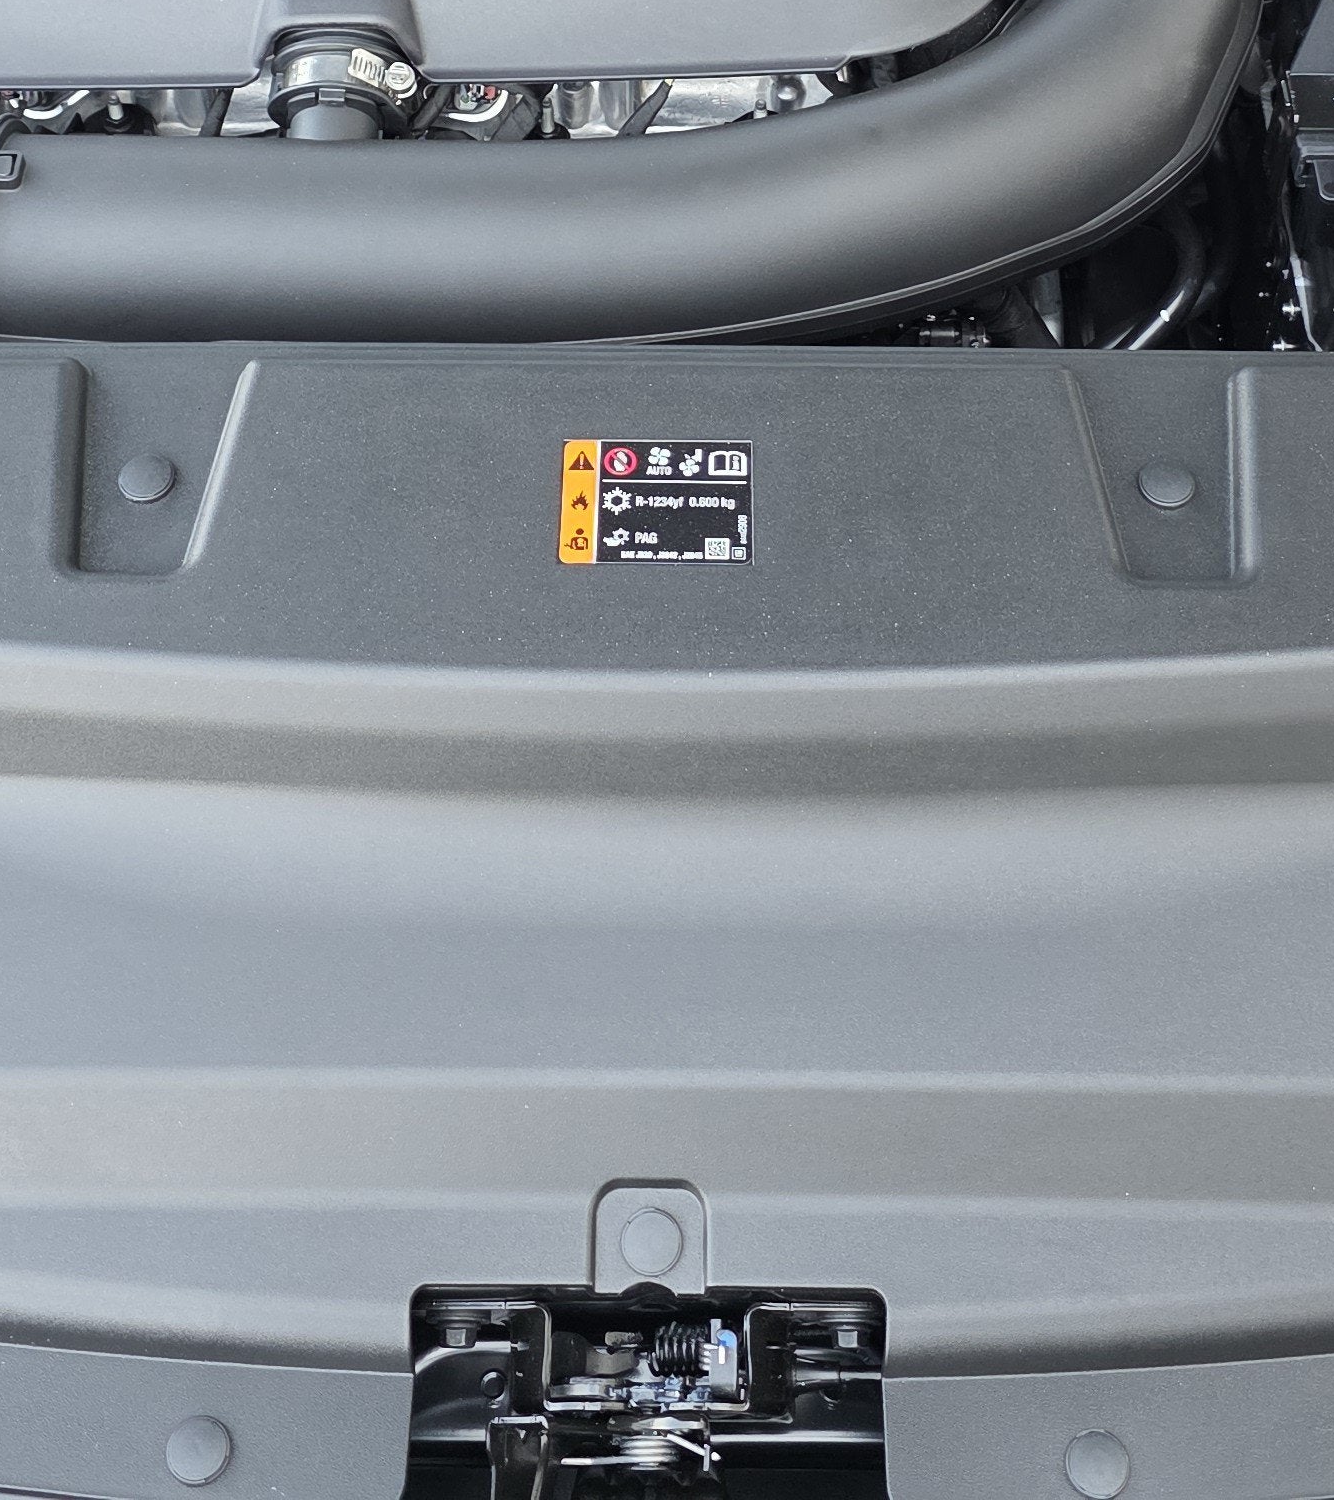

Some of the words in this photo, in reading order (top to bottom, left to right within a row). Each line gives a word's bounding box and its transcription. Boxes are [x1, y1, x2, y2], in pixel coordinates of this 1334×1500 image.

[646, 466, 672, 476] AUTO
[635, 496, 684, 509] R-1234yf
[721, 497, 736, 510] kg
[634, 532, 658, 544] PAG
